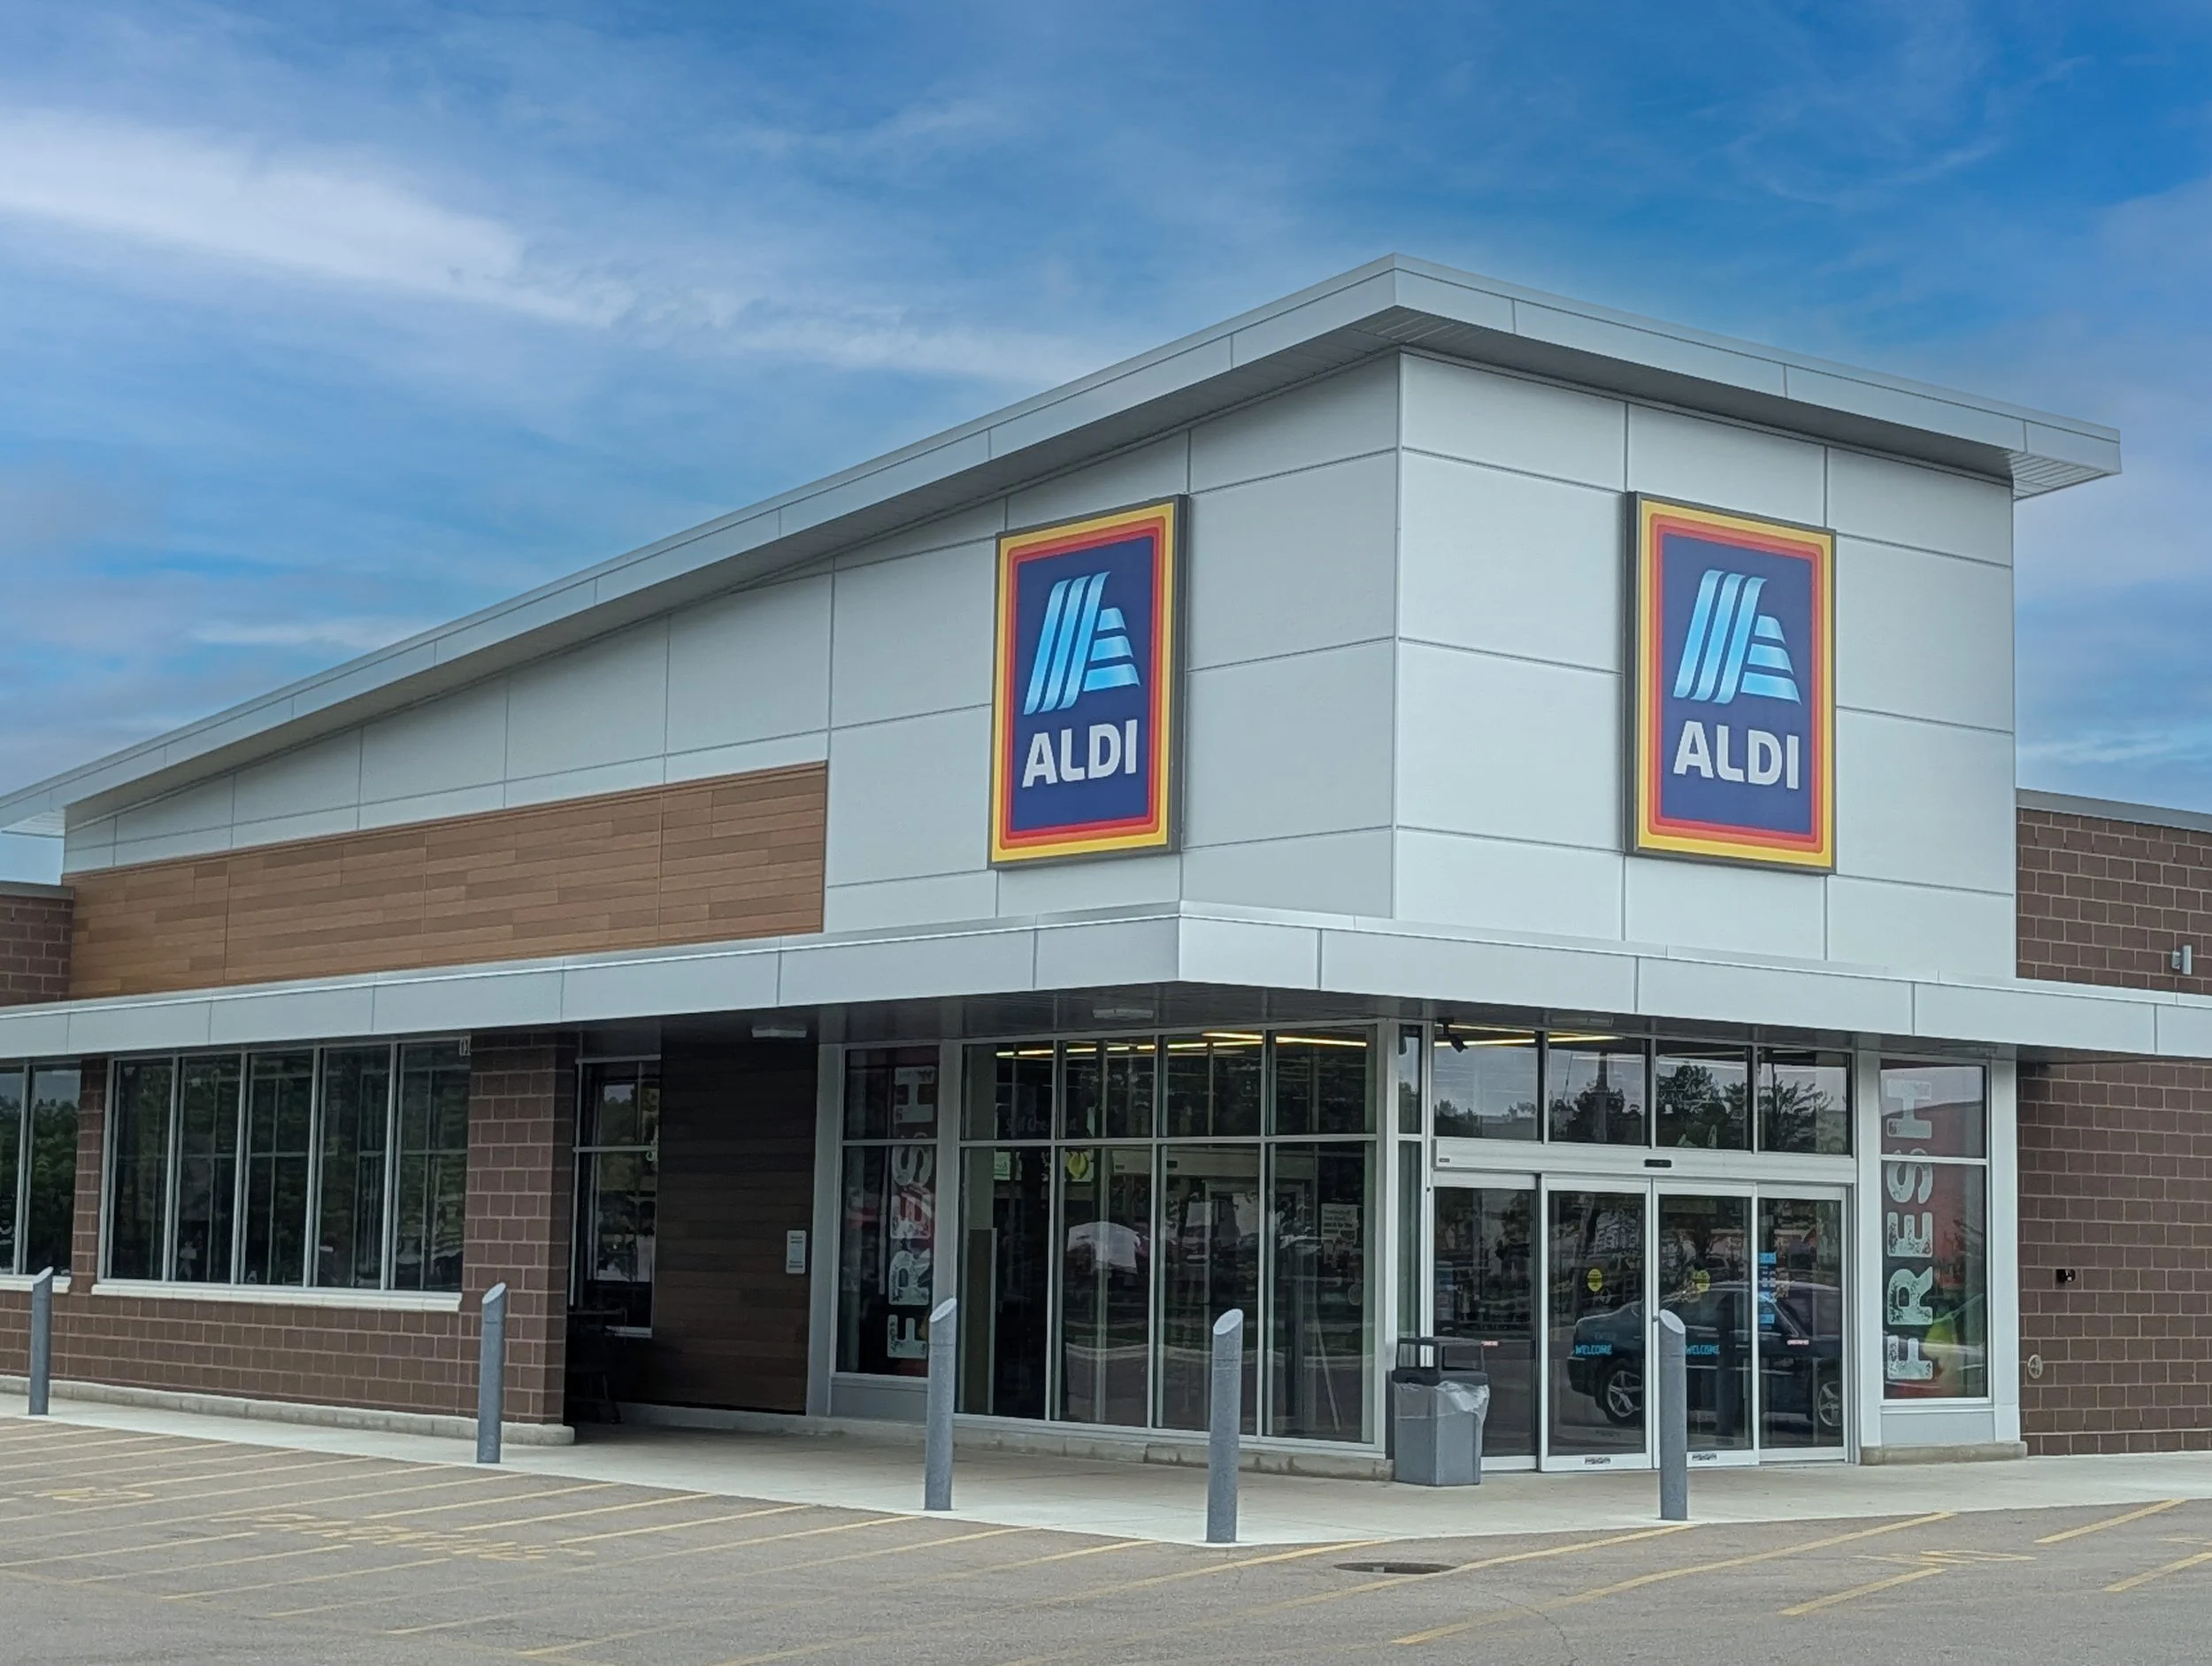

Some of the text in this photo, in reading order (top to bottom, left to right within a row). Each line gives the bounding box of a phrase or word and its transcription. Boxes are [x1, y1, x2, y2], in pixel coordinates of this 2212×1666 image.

[1022, 719, 1138, 788] ALDI
[1673, 720, 1800, 790] ALDI
[887, 1065, 935, 1358] FRESH
[1886, 1079, 1933, 1380] FRESH
[1575, 1344, 1612, 1355] WELCOME
